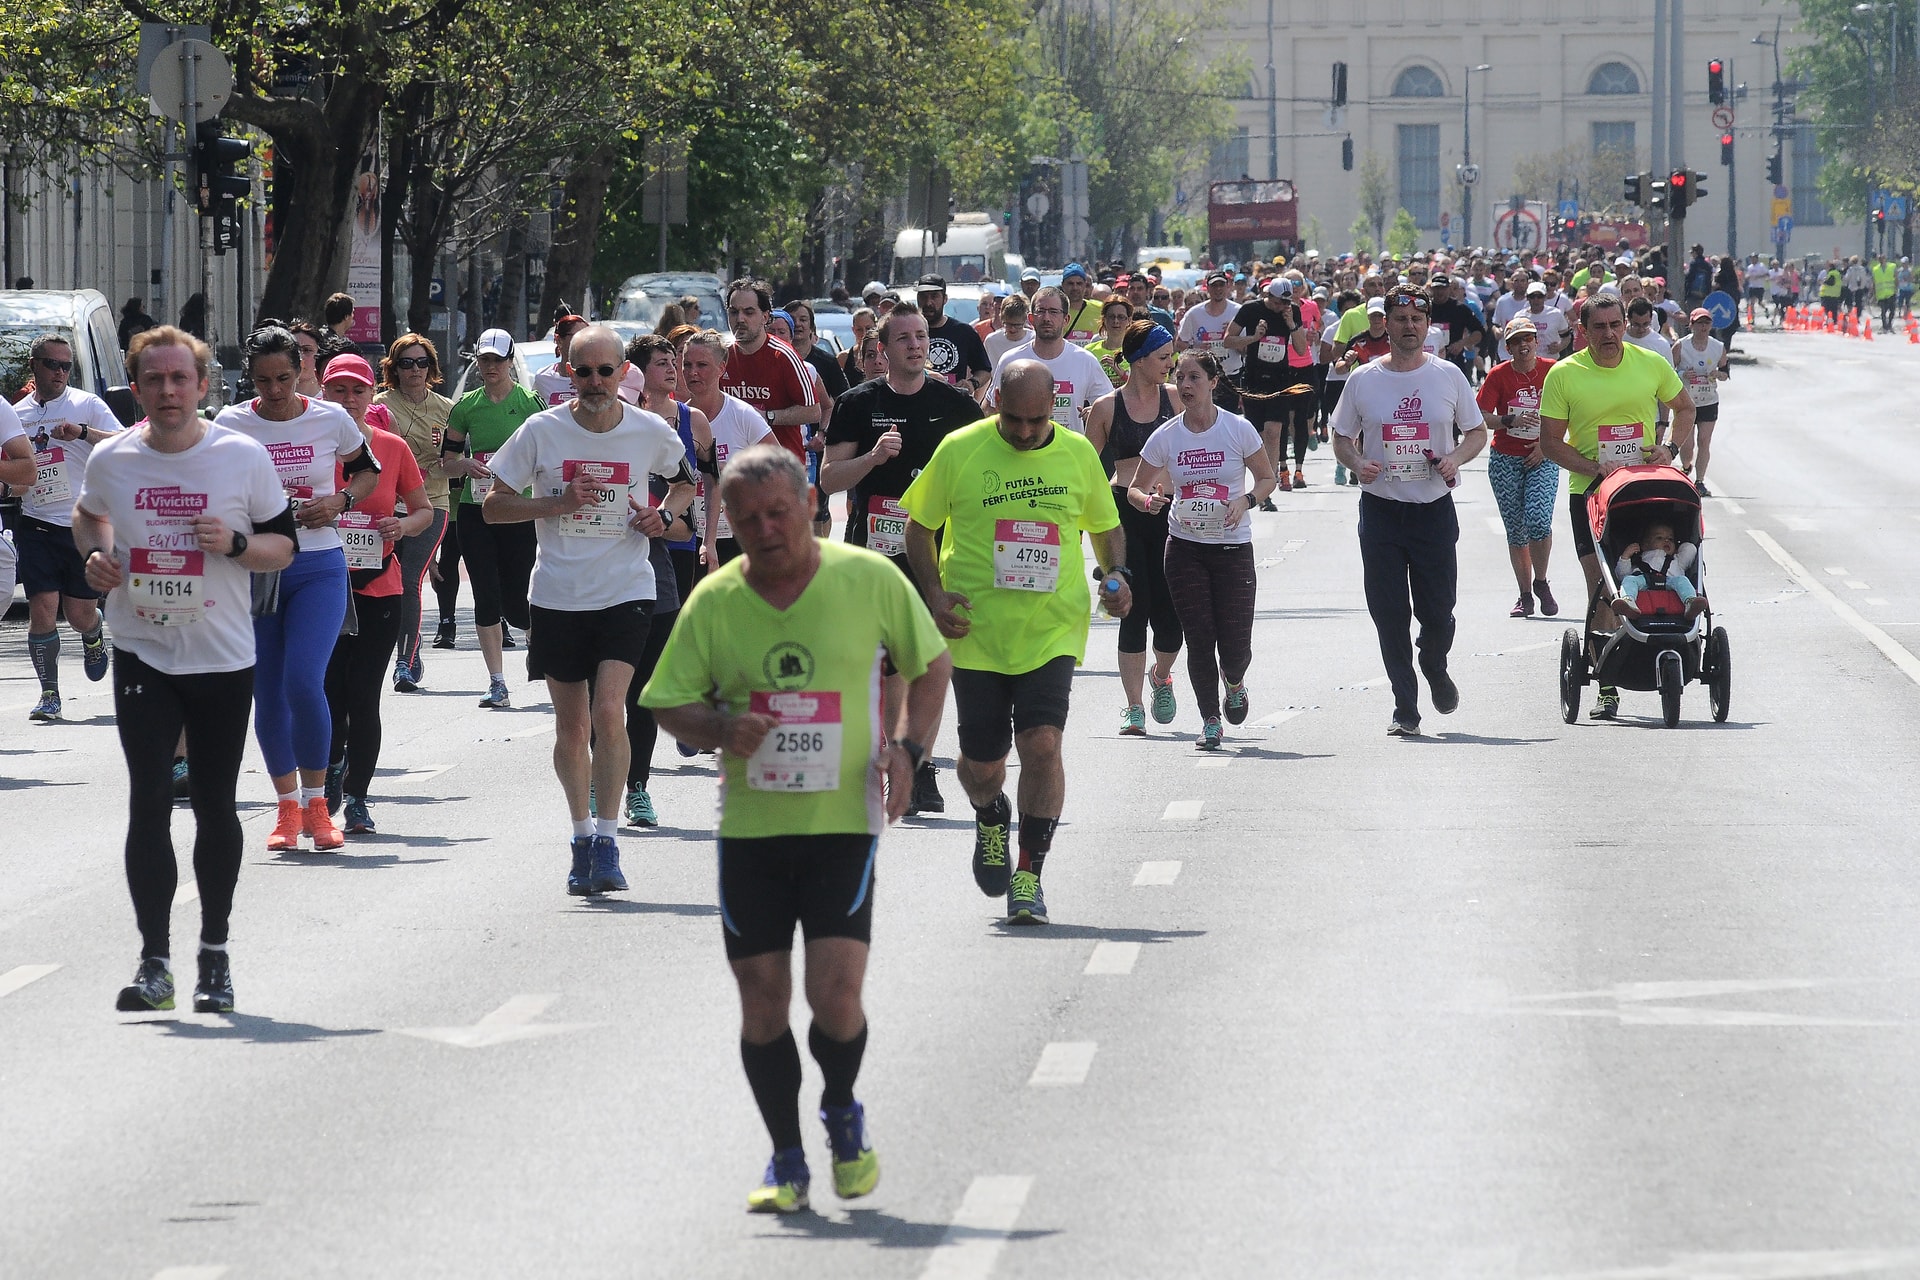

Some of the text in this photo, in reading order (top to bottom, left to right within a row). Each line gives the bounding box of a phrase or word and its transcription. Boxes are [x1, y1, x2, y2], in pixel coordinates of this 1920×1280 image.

[269, 447, 311, 460] Vivicittá
[1396, 444, 1420, 455] 8143
[1615, 442, 1637, 455] 2026
[1187, 452, 1222, 464] Vivicittá
[37, 467, 58, 480] 2576
[1005, 476, 1044, 490] FUTÁS A
[151, 495, 203, 508] Vivicittá
[982, 484, 1068, 507] FÉRFI EGÉSZSÉGÉRT
[1191, 501, 1215, 512] 2511
[877, 520, 904, 534] 1563
[346, 532, 374, 546] 8816
[1016, 547, 1048, 564] 4799
[133, 579, 140, 587] 5
[148, 580, 193, 597] 11614
[775, 732, 823, 753] 2586
